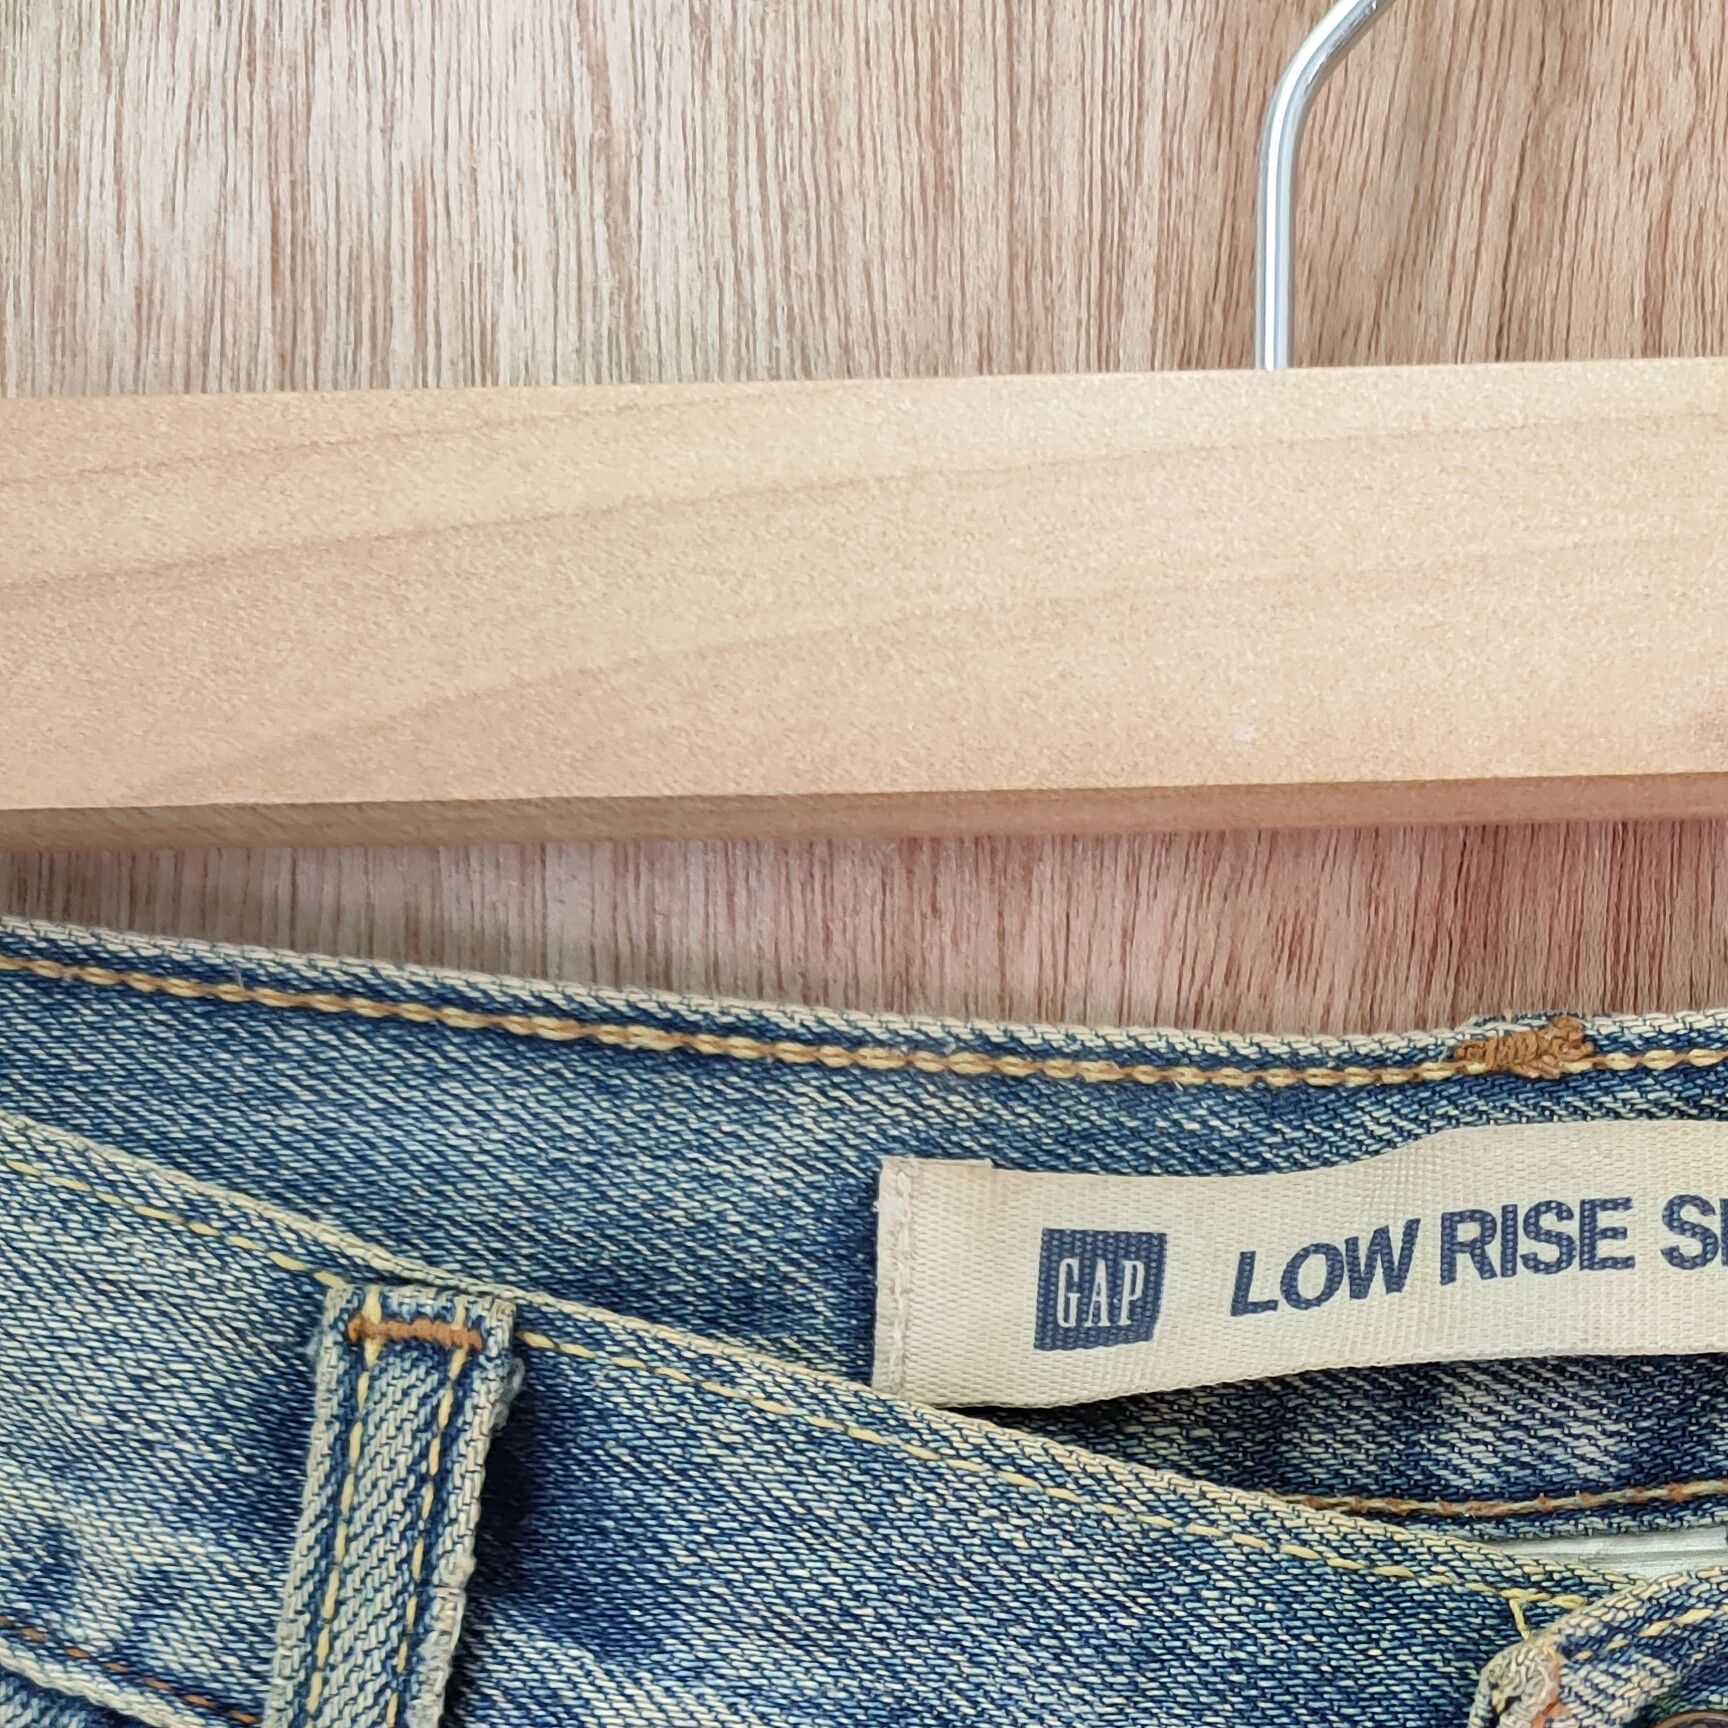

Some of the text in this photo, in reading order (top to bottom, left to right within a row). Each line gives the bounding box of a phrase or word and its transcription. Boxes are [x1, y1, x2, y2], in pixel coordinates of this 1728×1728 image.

[1056, 1257, 1144, 1327] GAP
[1231, 1219, 1421, 1317] LOW
[1440, 1197, 1635, 1286] RISE
